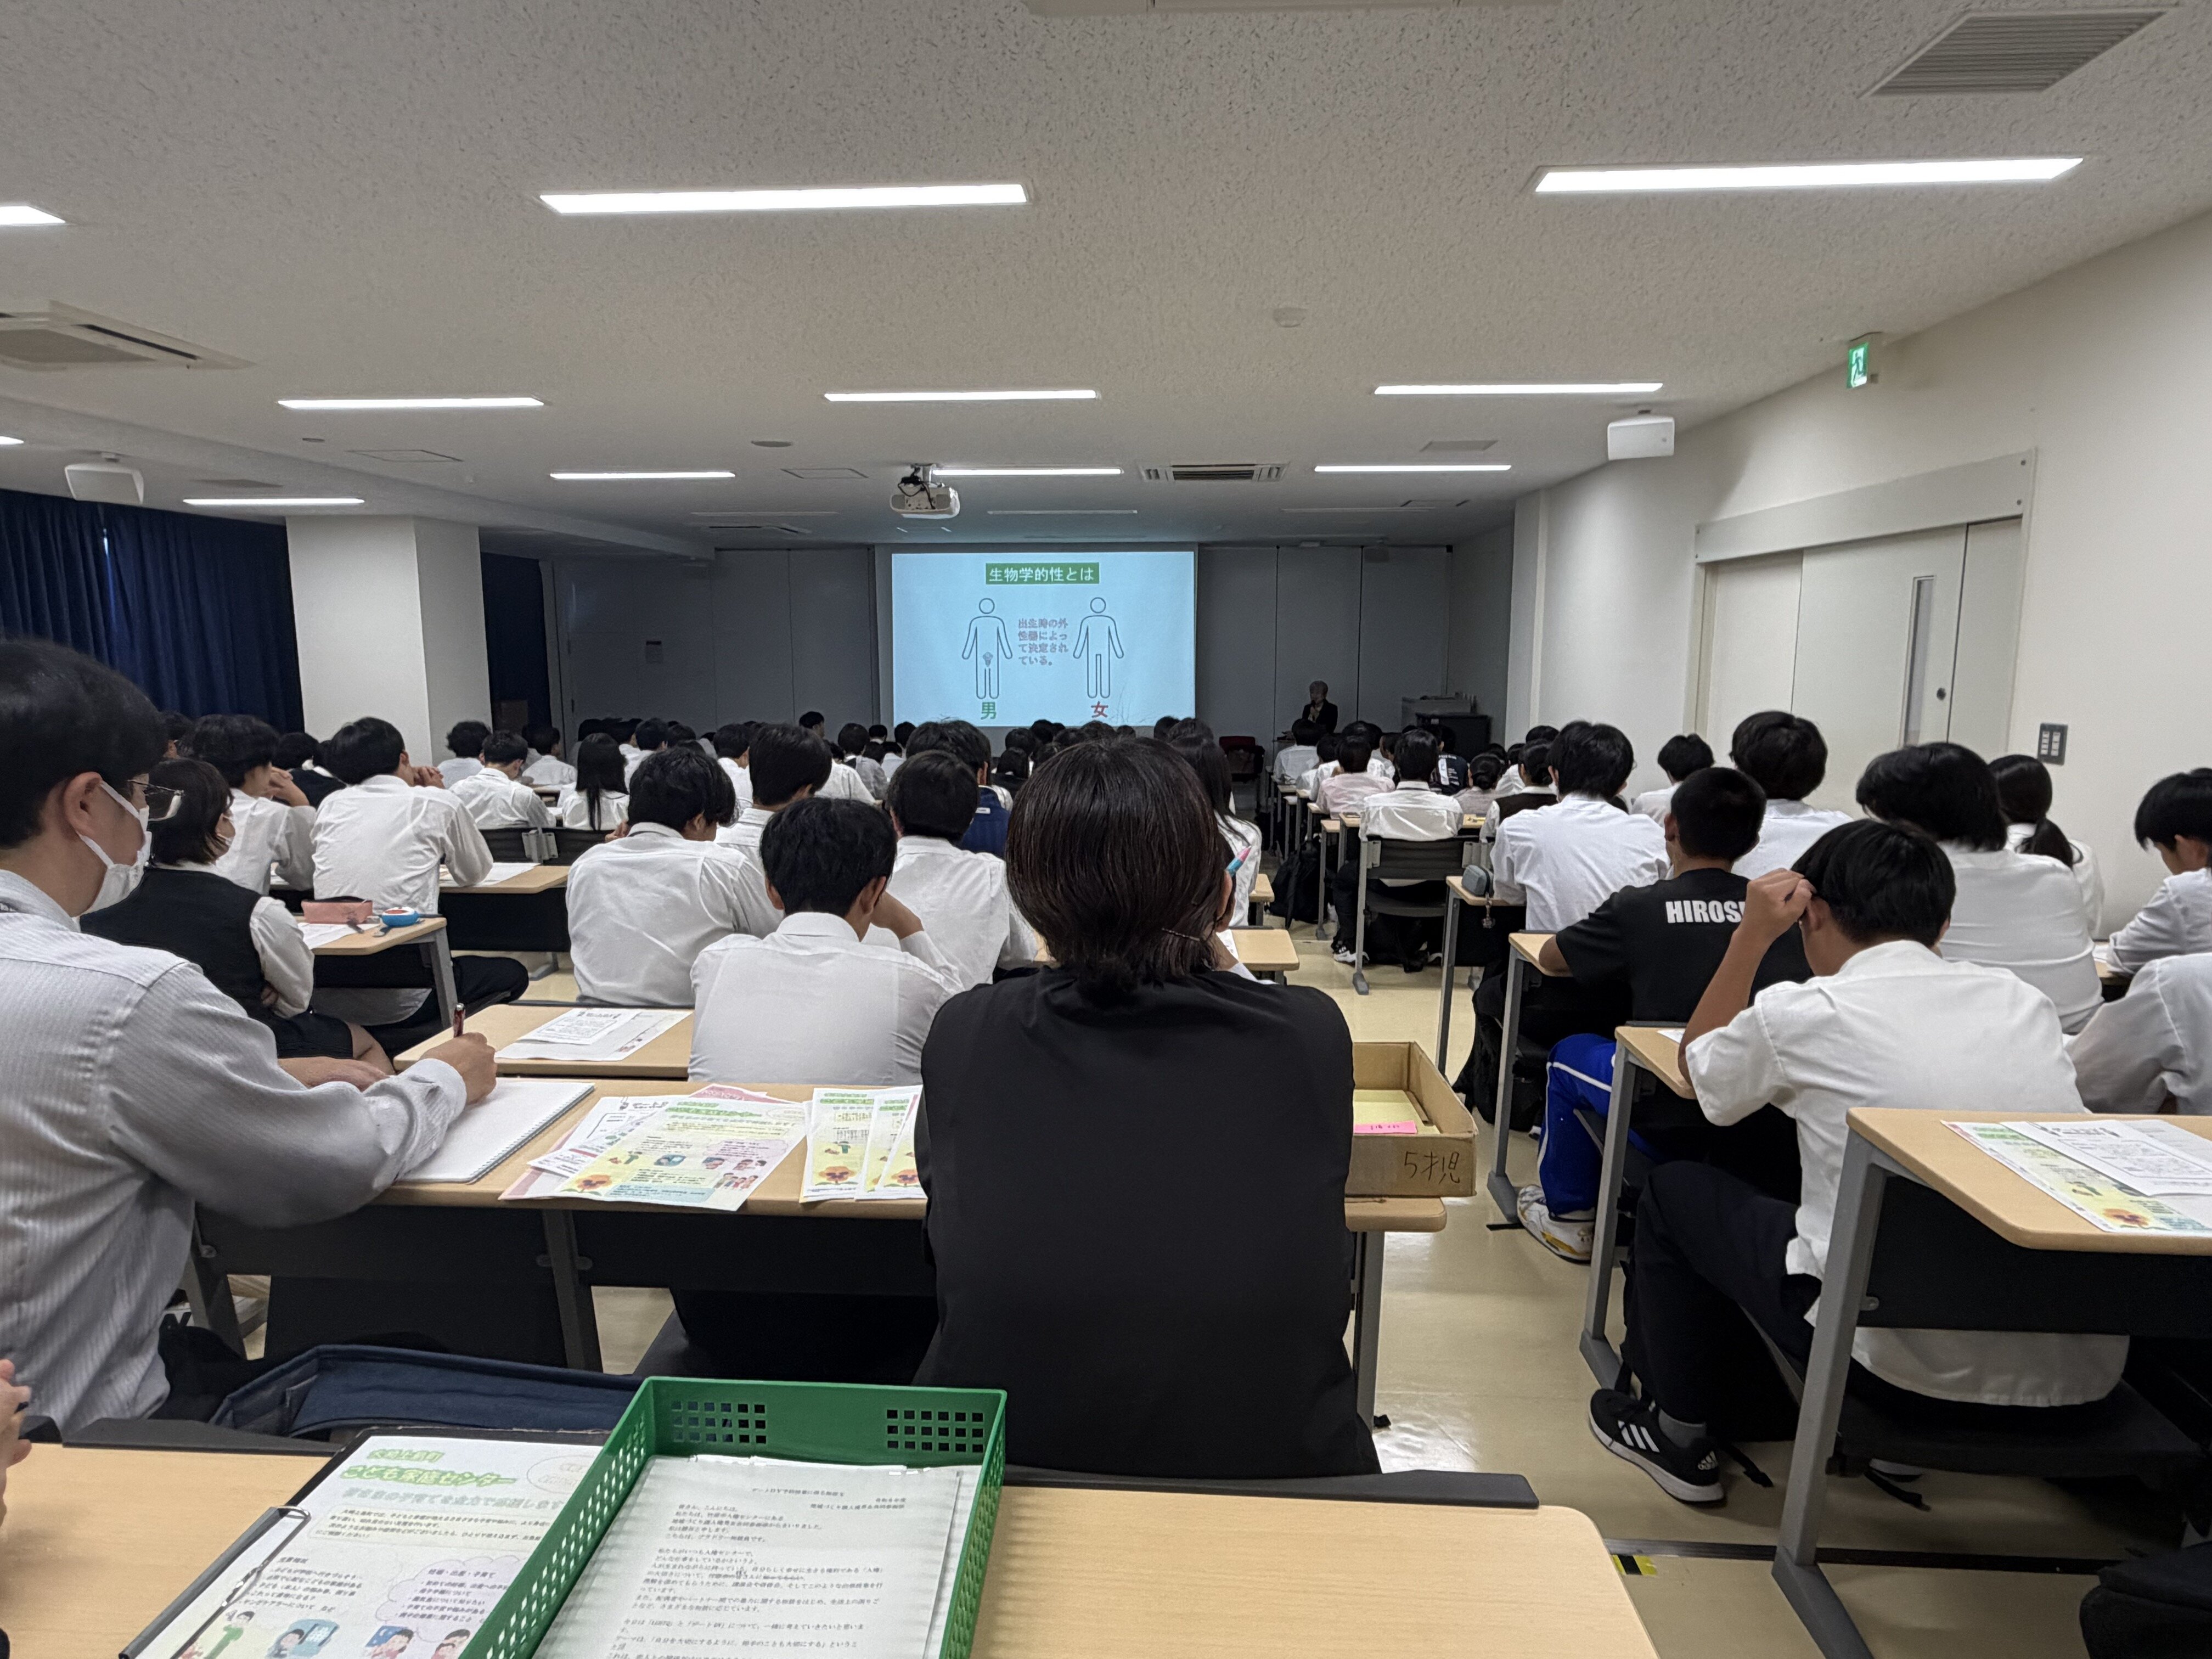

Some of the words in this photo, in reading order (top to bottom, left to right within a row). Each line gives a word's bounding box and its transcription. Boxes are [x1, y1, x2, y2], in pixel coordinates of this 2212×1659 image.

[988, 566, 1094, 582] 生物学的性とは
[1018, 618, 1068, 629] 出生時の外
[1018, 631, 1067, 641] 性器によっ
[1018, 643, 1068, 653] て決定され
[1018, 655, 1052, 666] ている。
[981, 702, 997, 721] 男
[1091, 701, 1109, 718] 女
[1665, 900, 1746, 924] HIROS
[1404, 1151, 1460, 1184] 5才児
[341, 1465, 519, 1487] こども家庭センター
